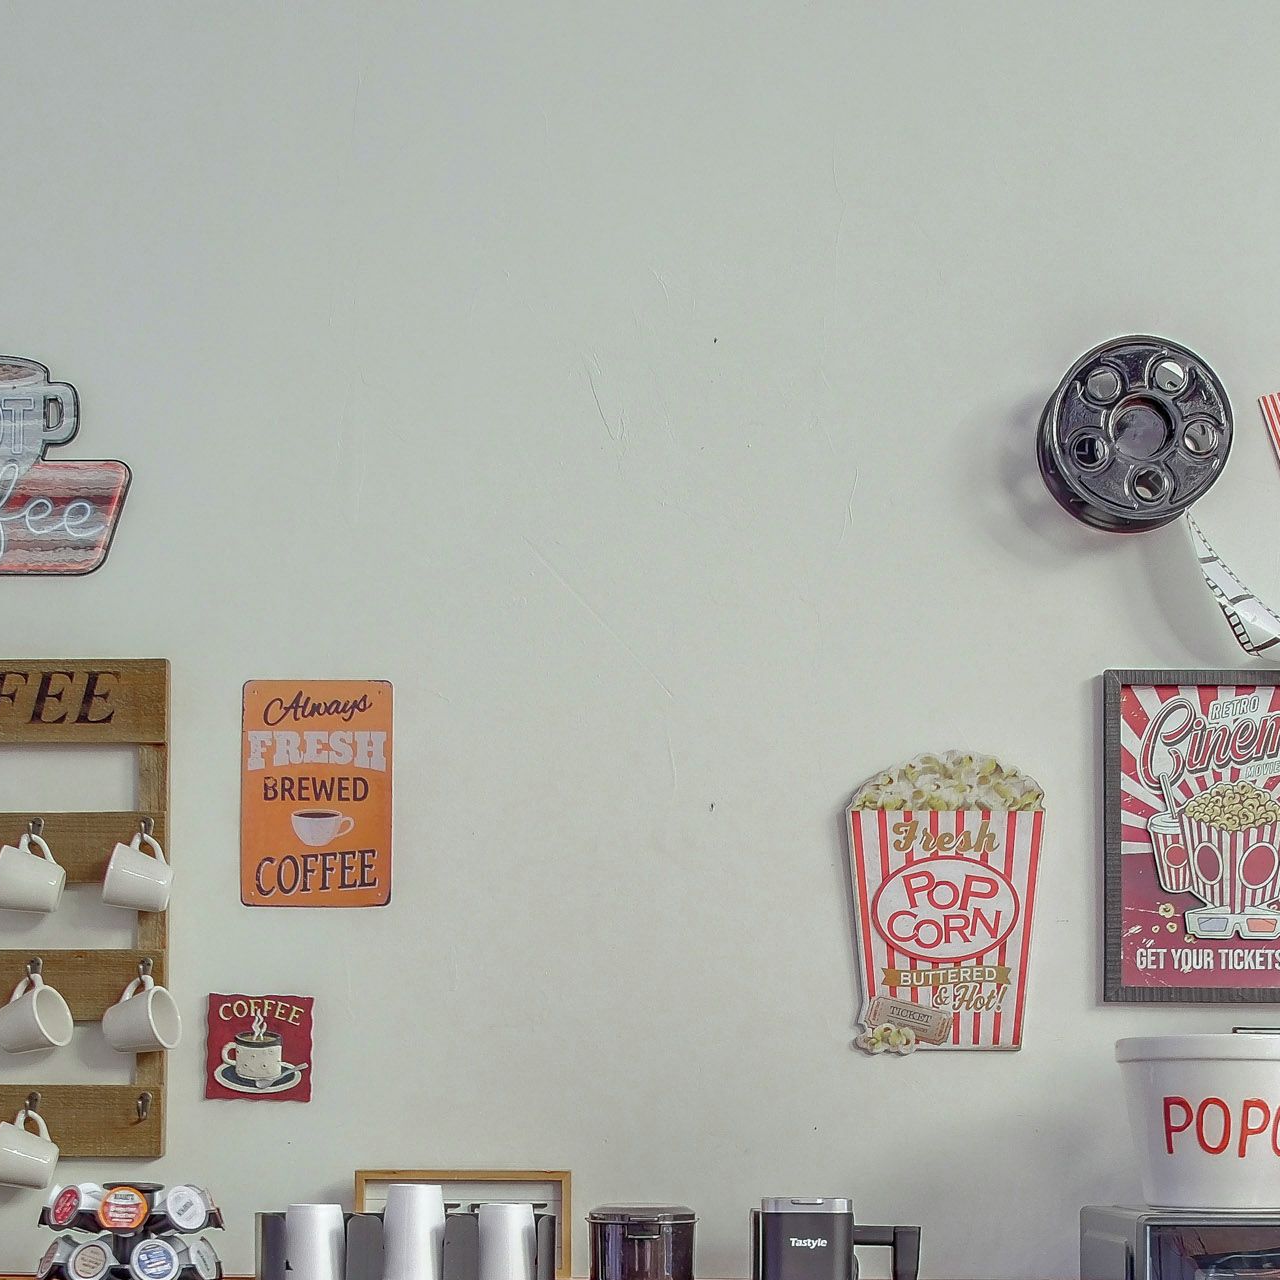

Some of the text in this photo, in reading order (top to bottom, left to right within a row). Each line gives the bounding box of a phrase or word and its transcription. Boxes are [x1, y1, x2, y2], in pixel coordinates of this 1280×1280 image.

[262, 690, 373, 727] Always
[1210, 696, 1260, 722] RETRO
[247, 730, 387, 772] FRESH
[1245, 761, 1280, 780] MOVIE
[263, 776, 369, 801] BREWED
[892, 819, 1000, 853] Fresh
[255, 849, 379, 897] COFFEE
[901, 869, 1000, 912] POP
[886, 907, 1002, 949] CORN
[1136, 950, 1167, 971] GET
[1170, 950, 1215, 971] YOUR
[899, 967, 997, 986] BUTTERED
[933, 984, 1008, 1012] & Hot!
[218, 999, 305, 1026] COFFEE
[889, 1005, 933, 1024] TICKET
[789, 1237, 828, 1250] Tastyle
